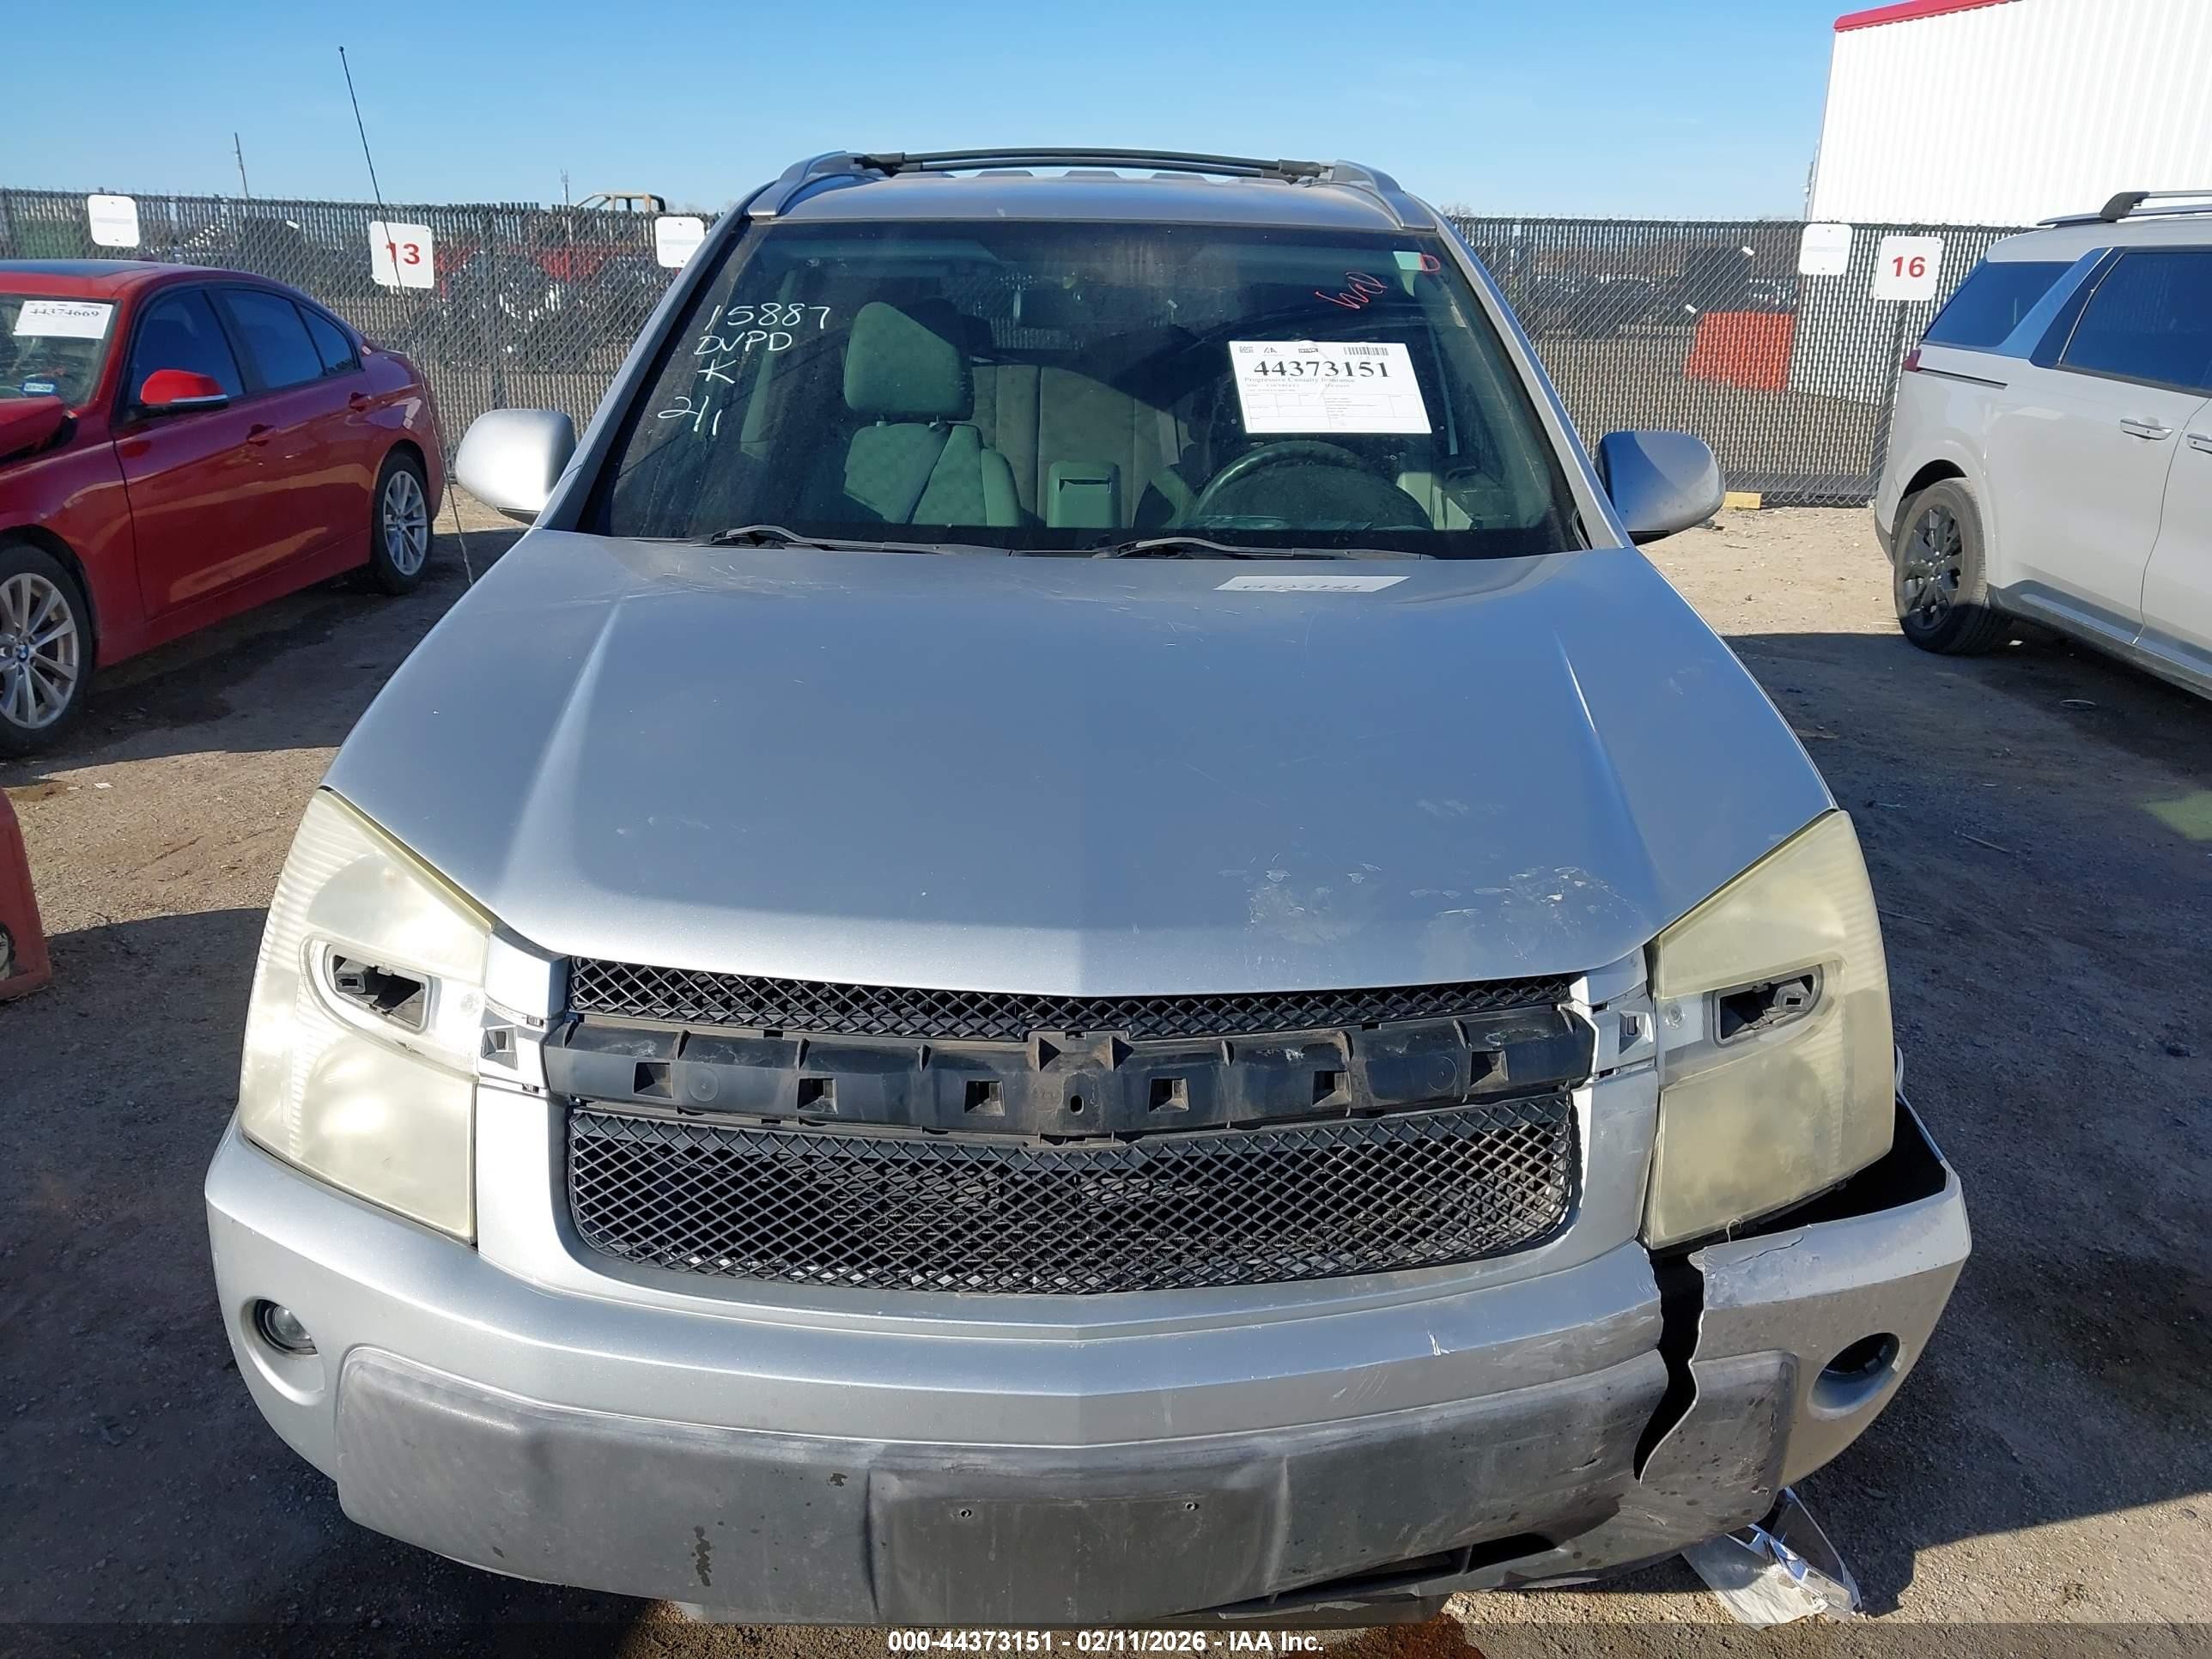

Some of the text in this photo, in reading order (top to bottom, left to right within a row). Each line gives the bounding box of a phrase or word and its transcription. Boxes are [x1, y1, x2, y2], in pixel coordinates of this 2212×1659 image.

[386, 242, 420, 264] 13
[1893, 256, 1926, 277] 16
[704, 302, 830, 331] 15887
[693, 330, 793, 355] DVPD
[697, 359, 737, 385] K
[1254, 360, 1391, 378] 44373151
